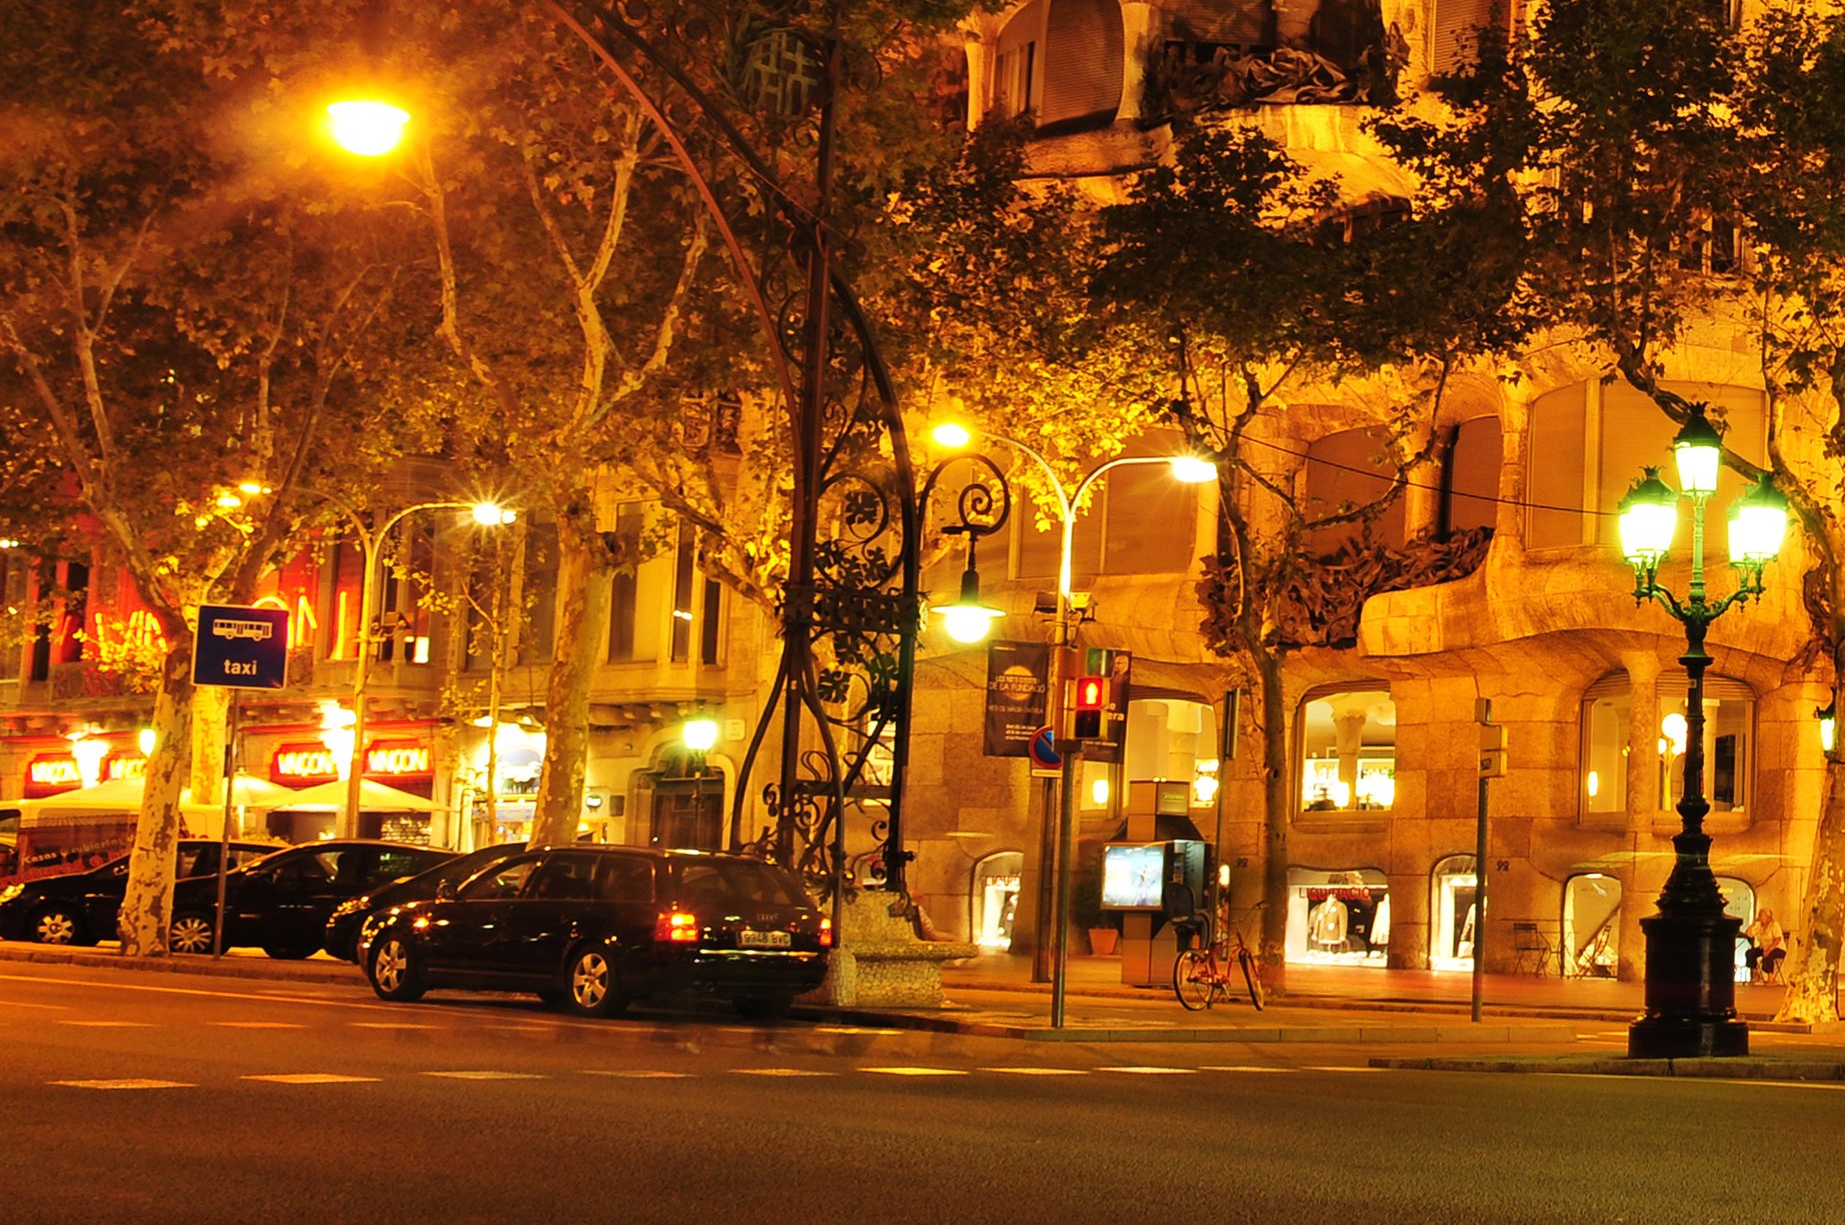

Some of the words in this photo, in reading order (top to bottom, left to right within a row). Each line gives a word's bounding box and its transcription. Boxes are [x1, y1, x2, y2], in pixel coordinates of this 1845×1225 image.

[223, 659, 257, 676] taxi
[277, 752, 334, 777] VINÇON
[367, 748, 429, 774] VINÇON
[1497, 860, 1509, 871] 92
